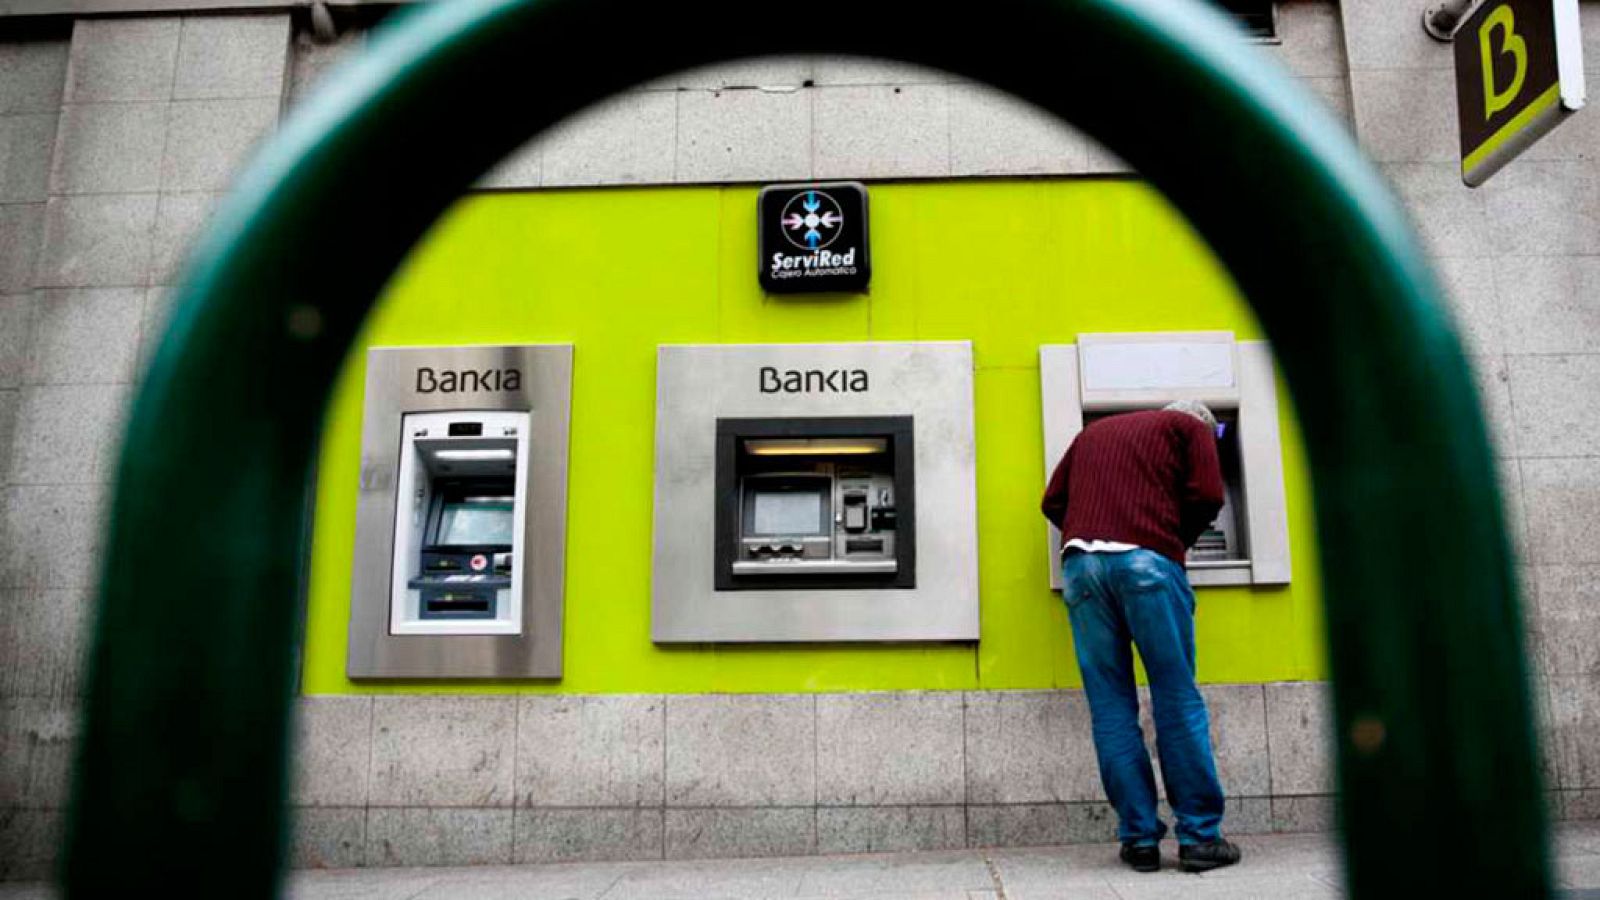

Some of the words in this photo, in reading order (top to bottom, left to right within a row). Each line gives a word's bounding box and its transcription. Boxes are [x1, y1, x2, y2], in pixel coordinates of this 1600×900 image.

[1478, 4, 1528, 120] B
[771, 247, 855, 269] ServiRed
[417, 367, 522, 393] Bankia
[759, 366, 869, 393] Bankia
